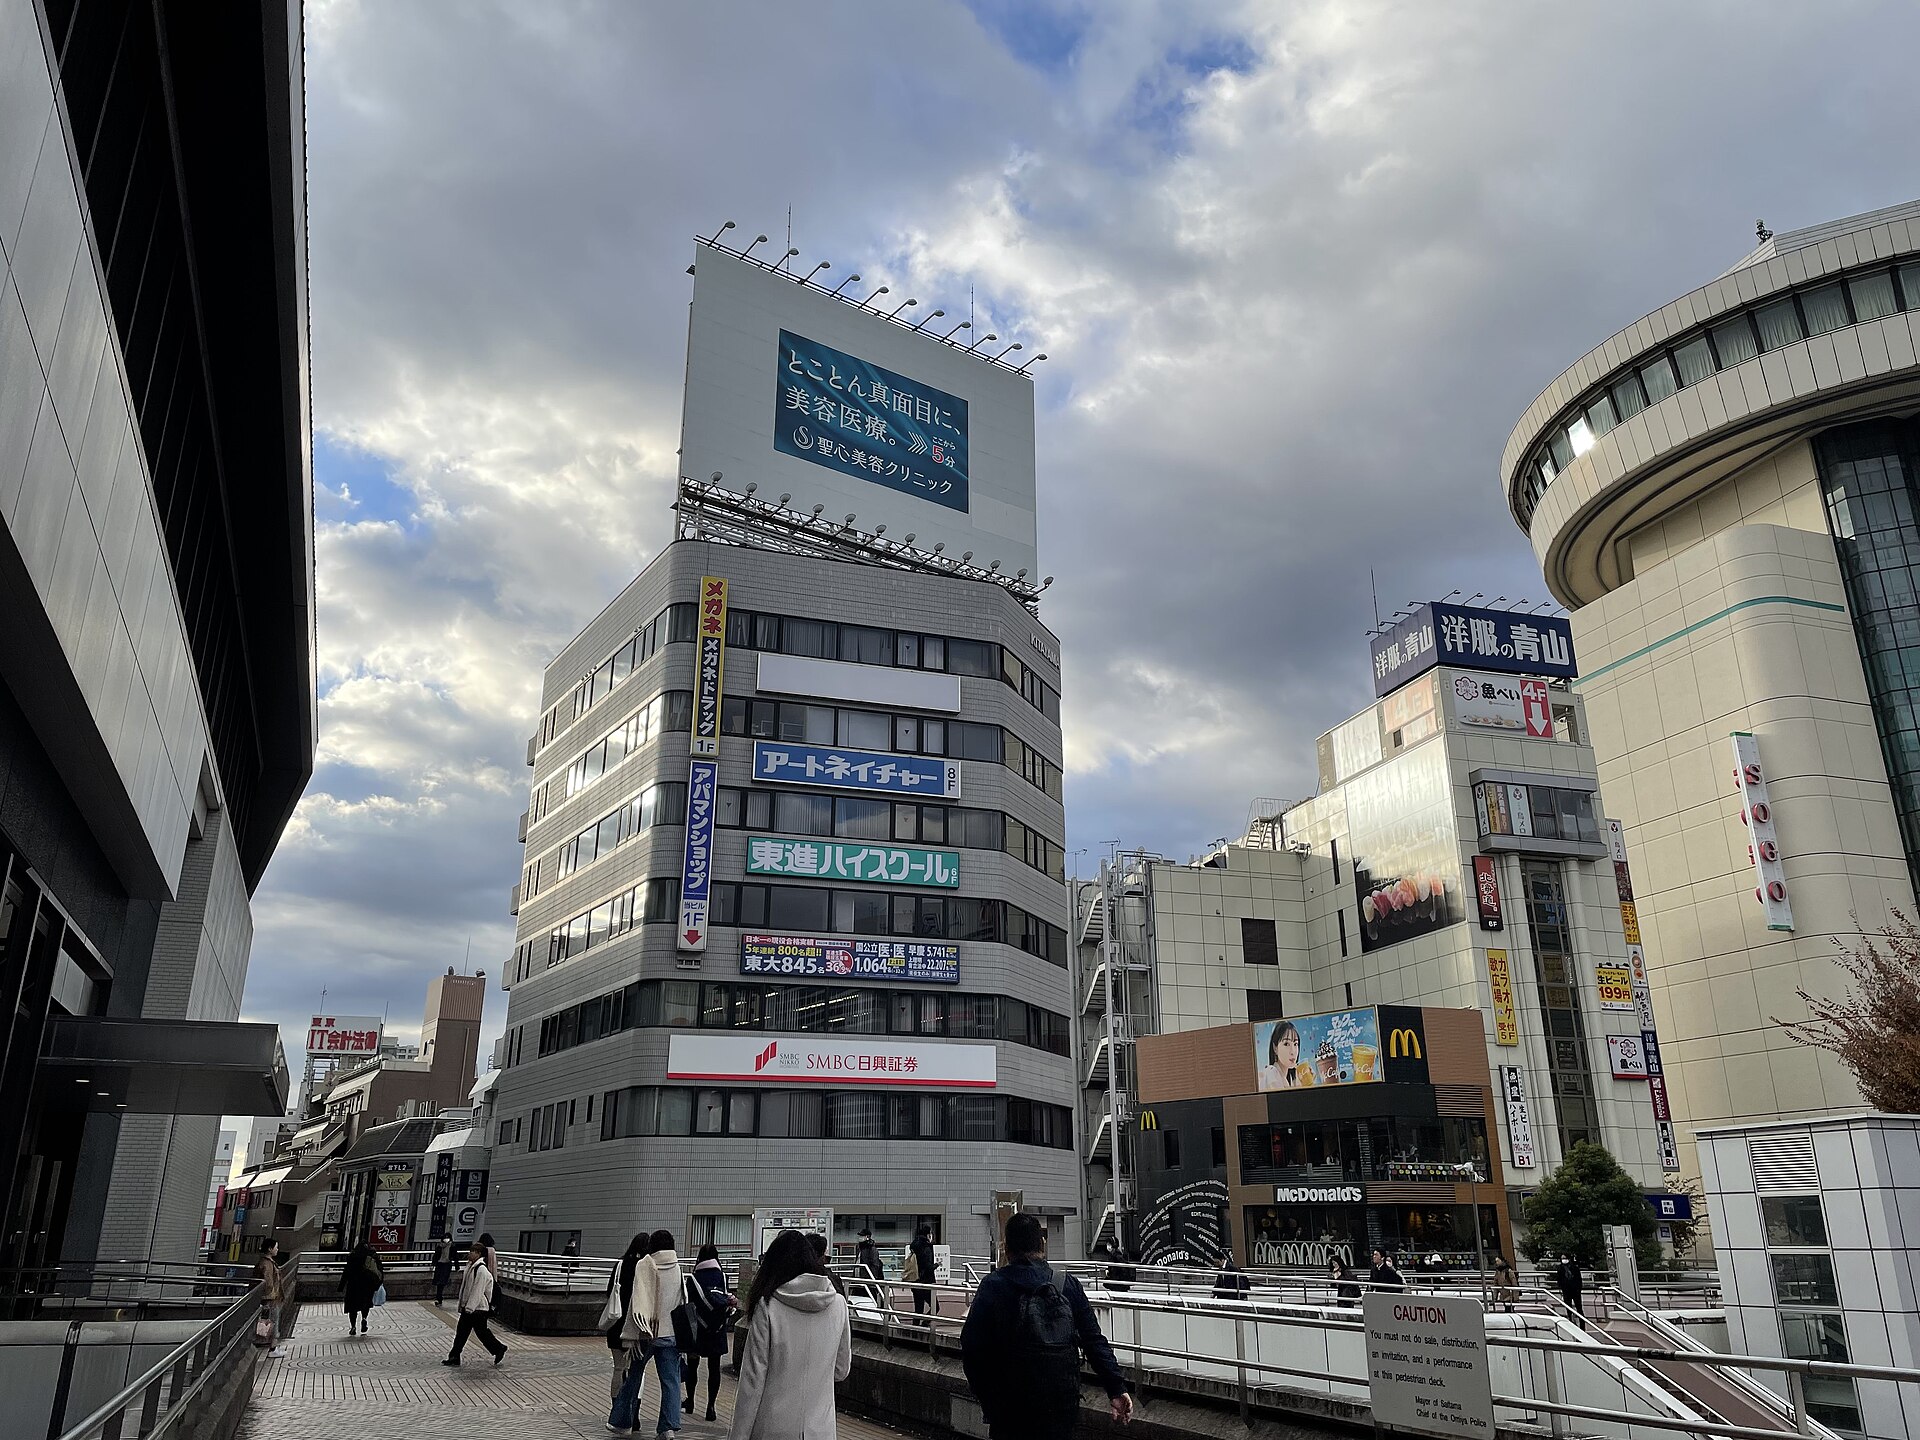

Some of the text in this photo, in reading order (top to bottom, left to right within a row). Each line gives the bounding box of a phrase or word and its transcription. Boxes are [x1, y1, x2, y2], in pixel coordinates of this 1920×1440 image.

[788, 349, 961, 436] とことん真面目に、
[786, 385, 896, 446] 美容医療。
[931, 436, 957, 451] ここから
[817, 435, 953, 494] 聖心美容クリニック
[931, 445, 956, 468] 5分
[702, 580, 724, 635] メガネ
[1440, 614, 1570, 666] 洋服の青山
[1375, 624, 1434, 680] 洋服の青山
[698, 639, 719, 736] メガネドラッグ
[1481, 682, 1521, 701] 魚べい
[1523, 682, 1546, 702] 4F
[696, 739, 715, 753] 1F
[762, 750, 938, 786] アートネイチャー
[947, 767, 956, 791] 8F
[687, 767, 712, 889] アパマンショップ
[1745, 763, 1787, 903] SOGO
[750, 840, 949, 884] 東進ハイスクール
[951, 867, 957, 885] 6F
[684, 901, 706, 910] 当ビル
[683, 911, 705, 927] 1F
[745, 944, 776, 955] 5年連続
[777, 945, 822, 957] 800名超!!
[745, 955, 825, 974] 東大845名
[1489, 957, 1503, 1004] 歌広場
[1498, 957, 1513, 1020] カラオケ
[1597, 974, 1629, 986] 生ビール
[1599, 986, 1631, 1000] 199円
[311, 1017, 336, 1027] 東京
[1498, 1022, 1515, 1032] 受付
[308, 1029, 378, 1051] IT会計法律
[1500, 1031, 1516, 1041] 5F
[779, 1052, 800, 1060] SMBC
[806, 1053, 918, 1073] SMBC日興証券
[1619, 1058, 1643, 1070] 魚べい
[1509, 1104, 1520, 1142] ハイボール
[1519, 1104, 1530, 1142] 生ビール
[1518, 1155, 1531, 1166] B1
[1665, 1157, 1676, 1166] B1
[1276, 1186, 1363, 1203] McDonald's
[1155, 1250, 1190, 1266] Donald's
[1394, 1305, 1447, 1324] CAUTION
[1370, 1329, 1479, 1351] You must not do sale, distribution,
[1371, 1351, 1473, 1370] an invitation, and a performance
[1373, 1369, 1446, 1388] at this pedestrian deck.
[1415, 1396, 1462, 1411] Mayor of Saitama
[1416, 1408, 1487, 1428] Chief of the Omiya Police
